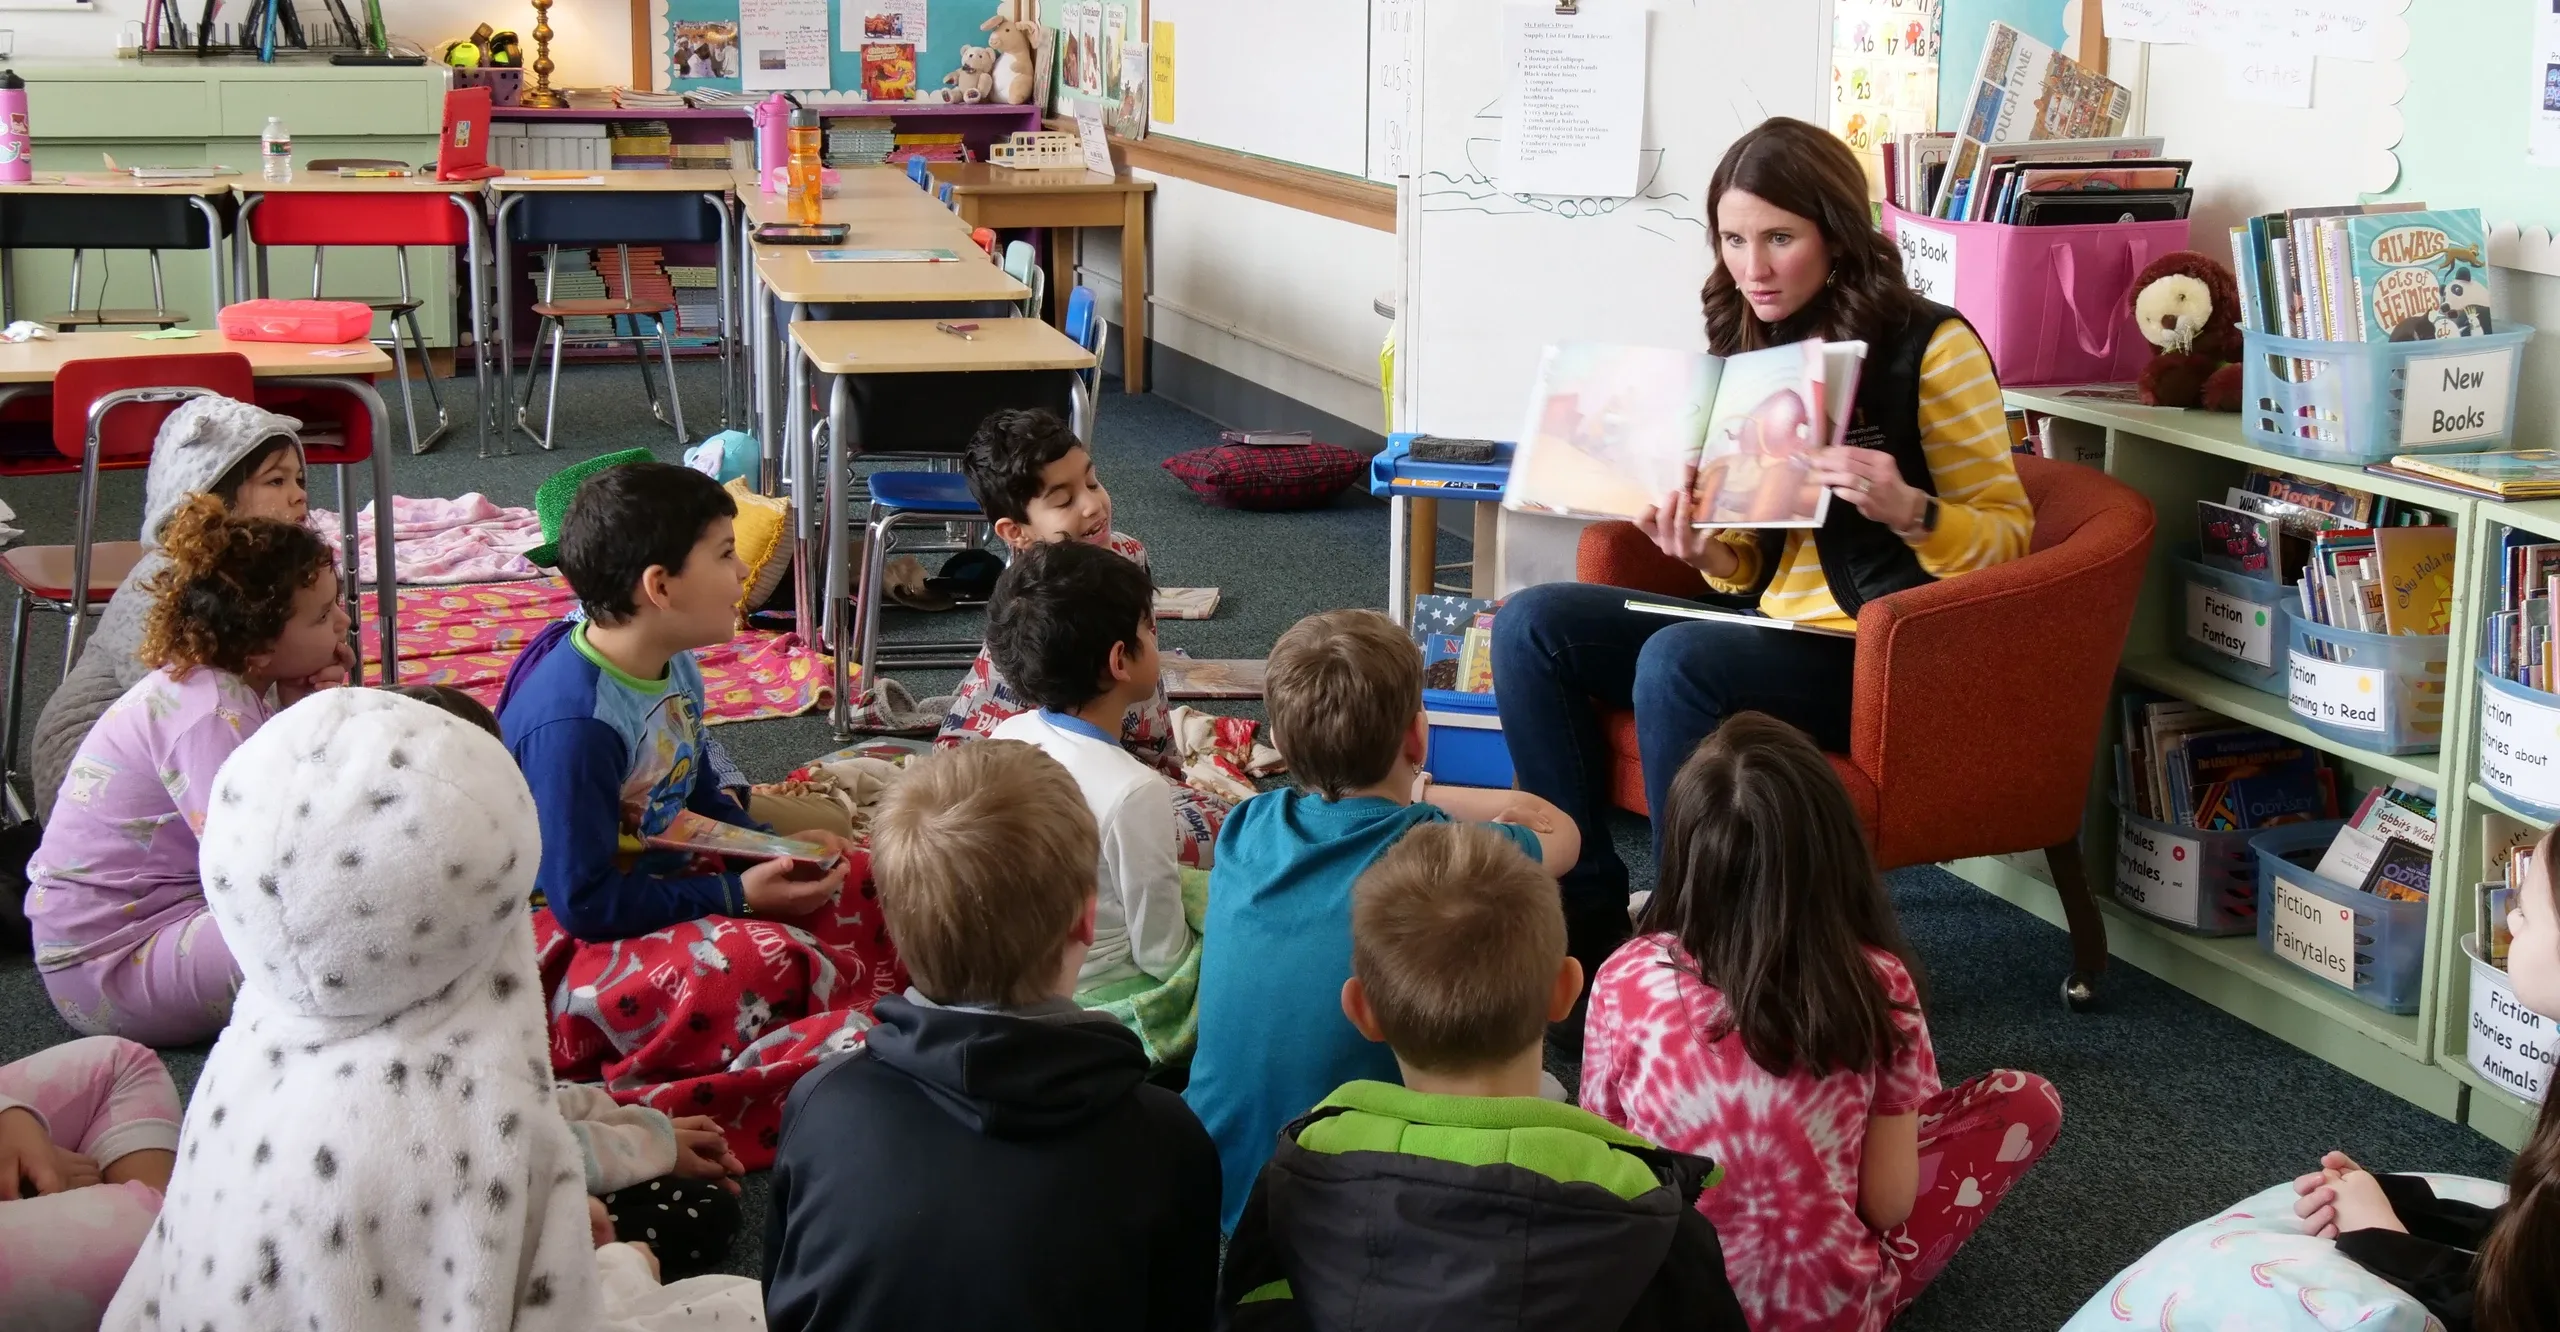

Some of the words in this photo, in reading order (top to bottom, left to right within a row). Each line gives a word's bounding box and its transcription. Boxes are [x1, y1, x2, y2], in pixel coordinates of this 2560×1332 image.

[1860, 35, 1875, 53] 16
[1887, 38, 1899, 55] 17
[1913, 38, 1926, 57] 18
[1155, 71, 1169, 83] Center
[2010, 48, 2032, 87] TIME
[1857, 81, 1871, 100] 23
[1850, 128, 1868, 149] 30
[1902, 230, 1916, 259] Big
[1921, 237, 1948, 264] Book
[2378, 229, 2448, 264] ALWAYS
[1914, 269, 1933, 294] Box
[2374, 286, 2441, 331] HEINIES
[2436, 319, 2452, 338] at
[2442, 366, 2485, 393] New
[2432, 405, 2485, 434] Books
[2268, 481, 2335, 513] Pigsty
[2392, 574, 2418, 609] Say
[2412, 555, 2441, 580] Hola
[2204, 596, 2243, 624] Fiction
[2202, 622, 2246, 656] Fantasy
[2290, 659, 2317, 687] Fiction
[2322, 701, 2335, 716] to
[2340, 703, 2376, 722] Read
[2482, 694, 2512, 727] Fiction
[2481, 727, 2510, 756] Stories
[2515, 748, 2548, 767] about
[2480, 755, 2513, 787] Children
[2251, 796, 2313, 817] ODYSSEY
[2374, 807, 2411, 832] Rabbit's
[2377, 822, 2392, 836] for
[2492, 846, 2510, 868] For
[2510, 828, 2530, 847] the
[2277, 886, 2322, 924] Fiction
[743, 920, 793, 981] WOOF!
[2276, 924, 2346, 973] Fairytales
[2490, 990, 2540, 1029] Fiction
[2472, 1012, 2513, 1050] Stories
[2482, 1054, 2538, 1093] Animals
